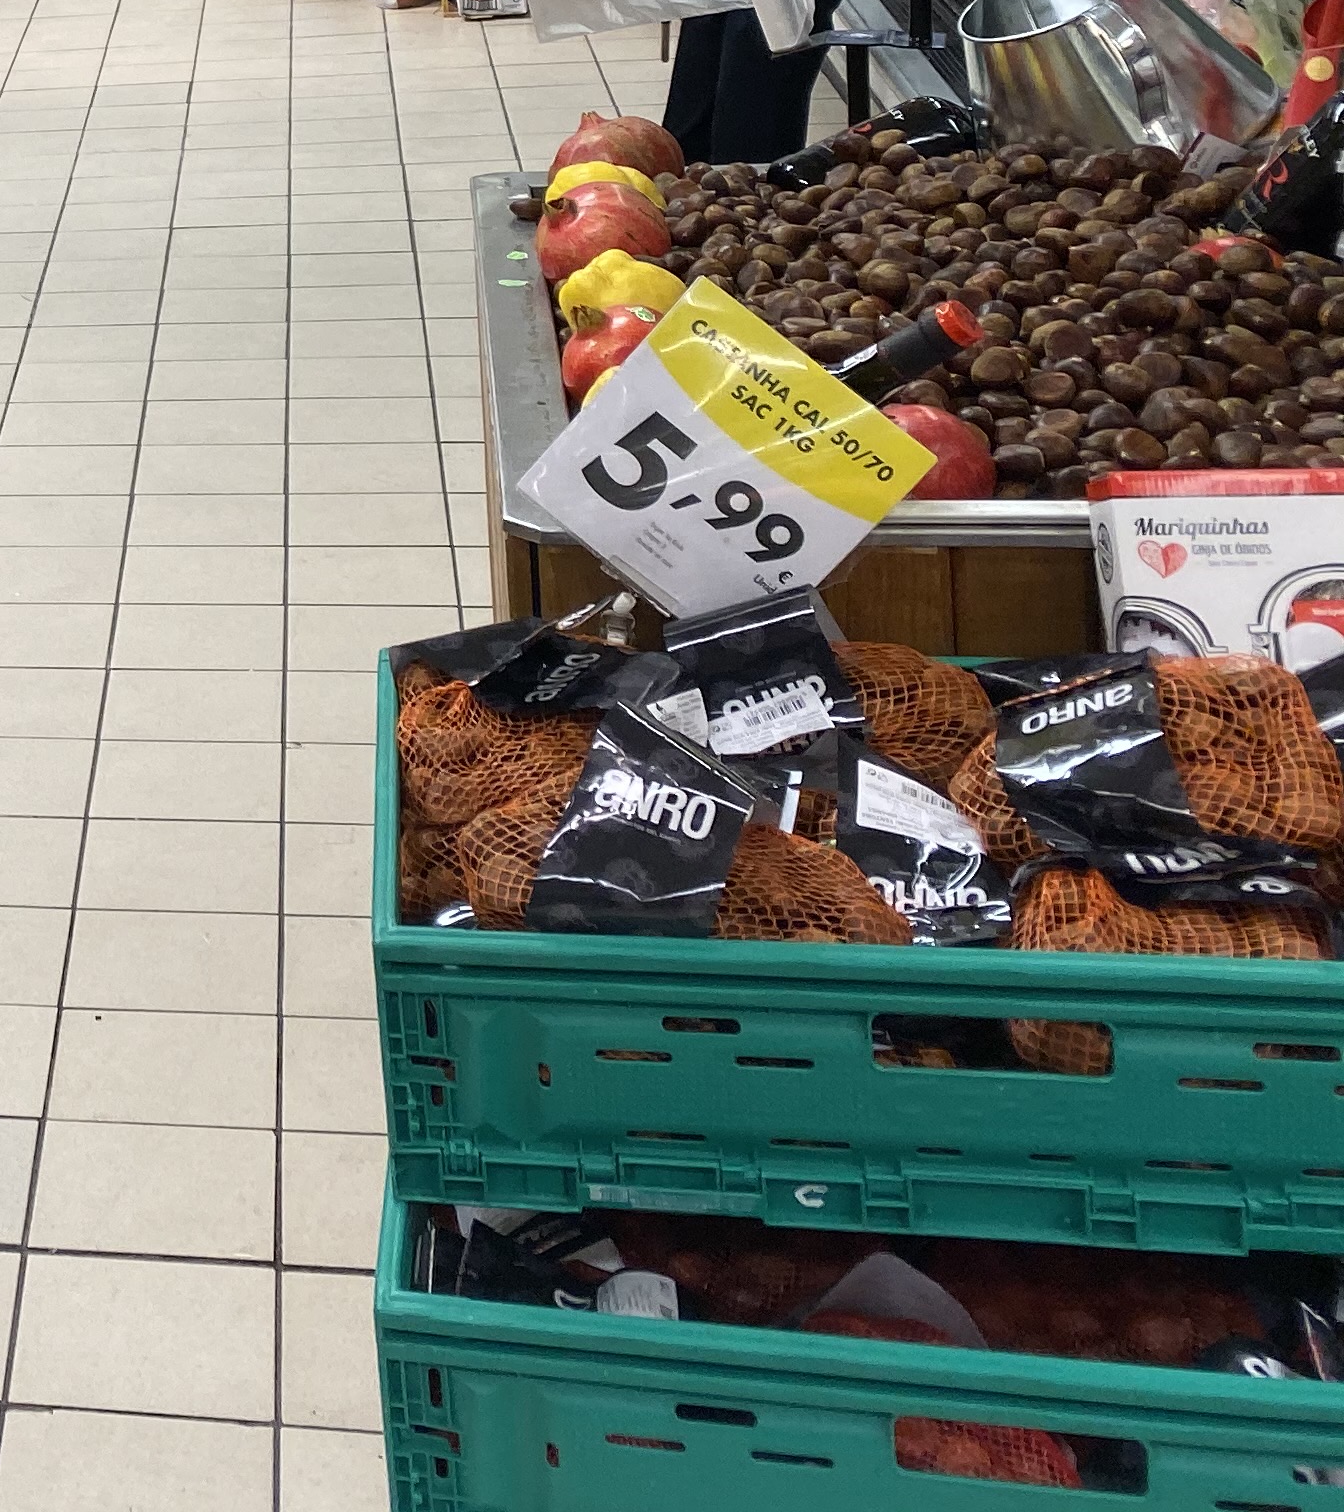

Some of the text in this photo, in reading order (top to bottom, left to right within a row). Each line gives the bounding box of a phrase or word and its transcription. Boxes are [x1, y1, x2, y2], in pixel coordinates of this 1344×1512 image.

[731, 383, 816, 456] SAC 1KG
[831, 429, 894, 483] 50/70
[581, 411, 804, 564] 5,99
[1135, 517, 1269, 539] Mariquinhas
[1191, 541, 1272, 558] GINJA DE ÓBIDOS
